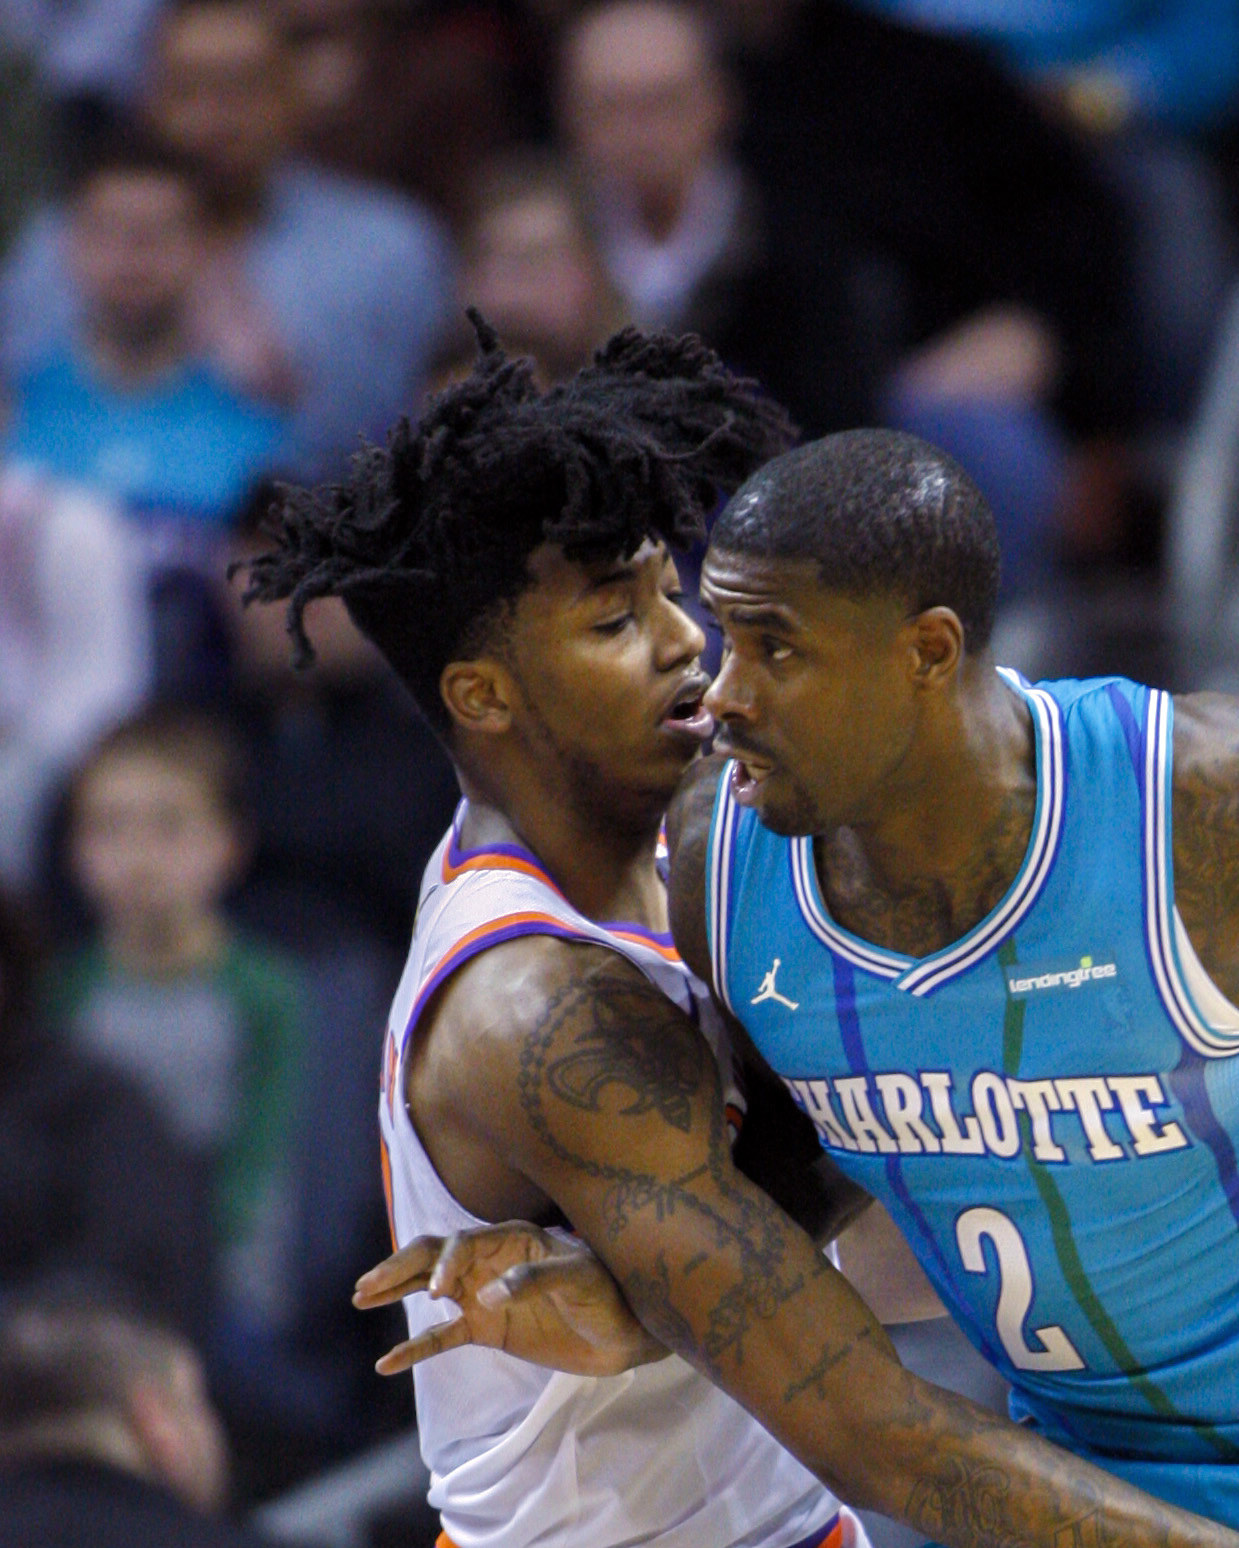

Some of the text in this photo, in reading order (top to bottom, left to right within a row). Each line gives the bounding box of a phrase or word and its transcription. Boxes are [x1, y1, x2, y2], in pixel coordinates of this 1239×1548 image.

[1008, 960, 1117, 993] lendingtree
[783, 1069, 1190, 1163] HARLOTTE
[955, 1206, 1086, 1372] 2
